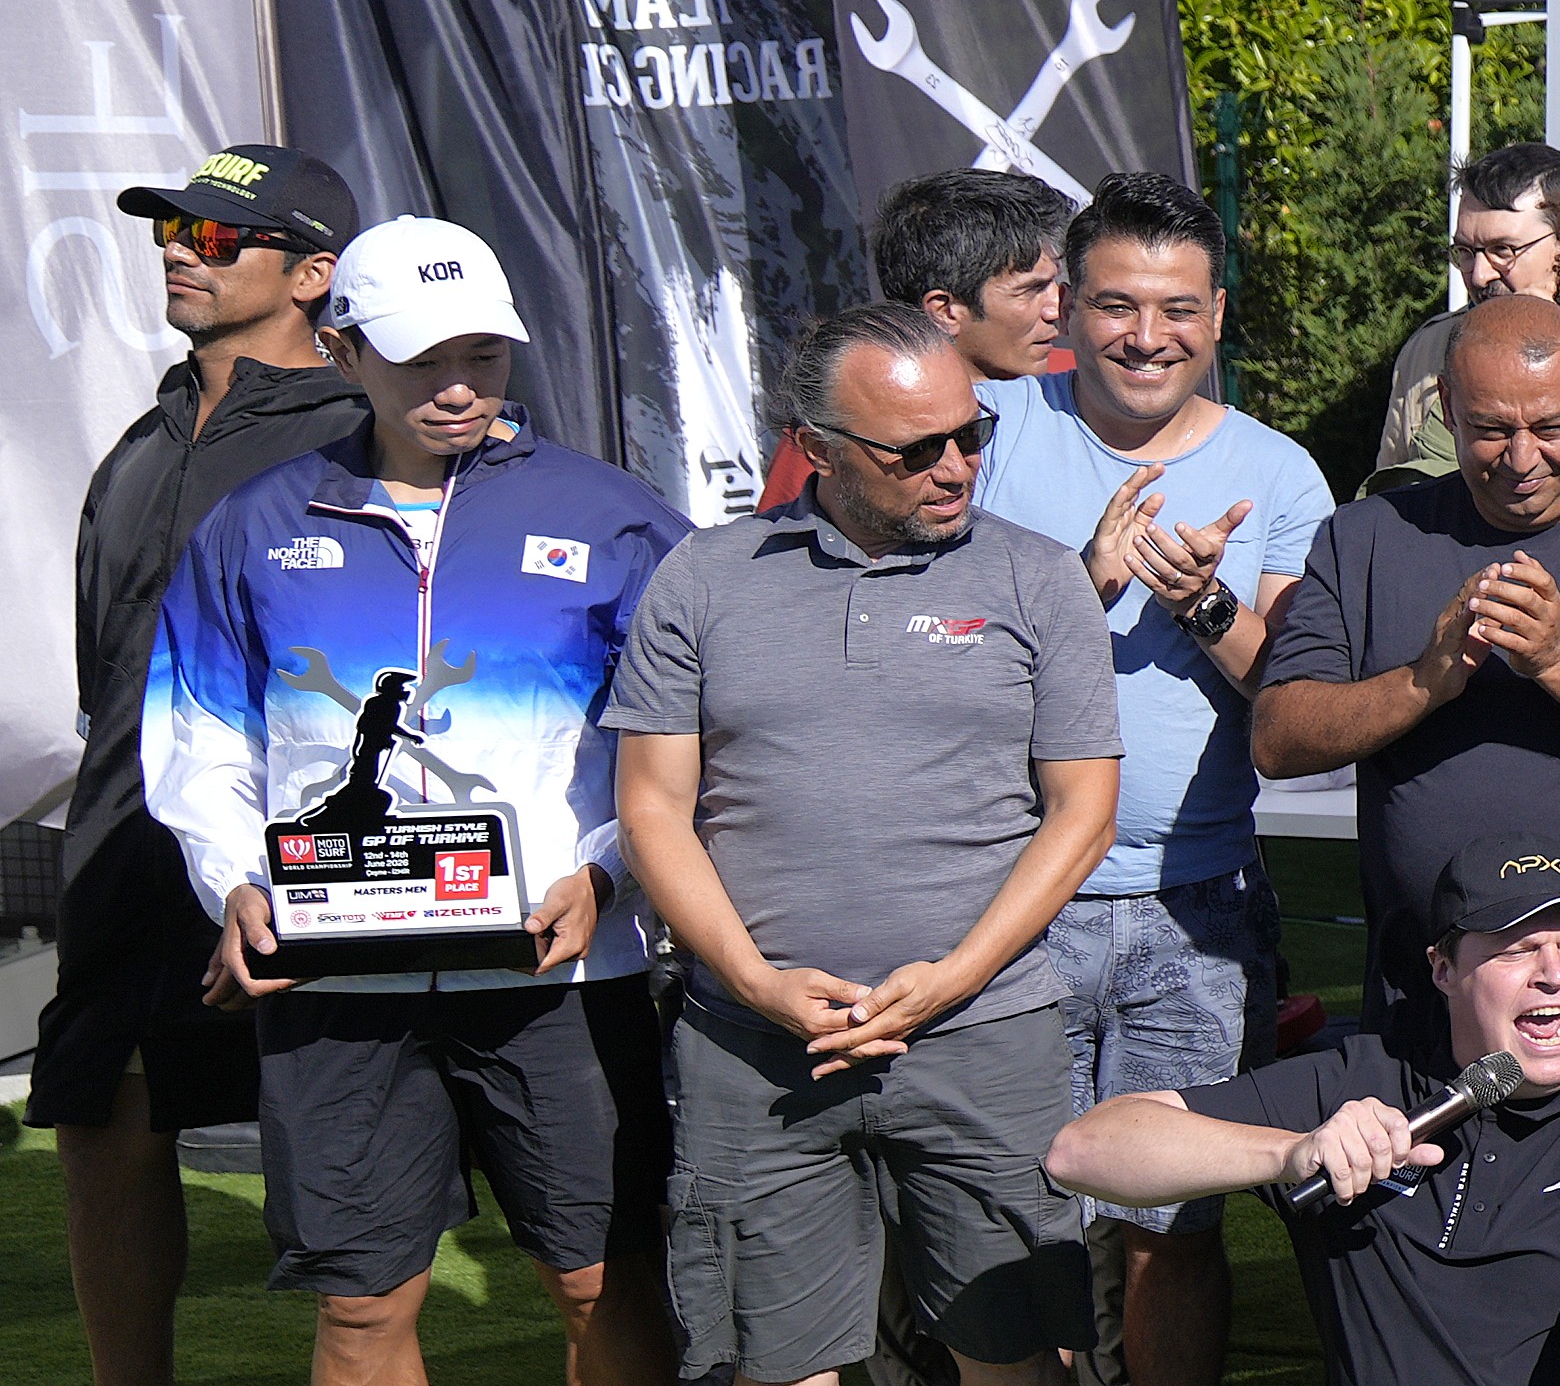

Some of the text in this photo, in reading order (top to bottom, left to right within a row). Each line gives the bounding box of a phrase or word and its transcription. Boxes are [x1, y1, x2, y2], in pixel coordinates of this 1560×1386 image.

[418, 260, 465, 284] KOR
[292, 536, 319, 549] THE
[267, 547, 319, 561] NORTH
[280, 558, 318, 570] FACE
[928, 633, 944, 644] OF
[437, 856, 484, 882] 1ST
[353, 885, 428, 896] MASTERS MEN
[445, 883, 479, 892] PLACE
